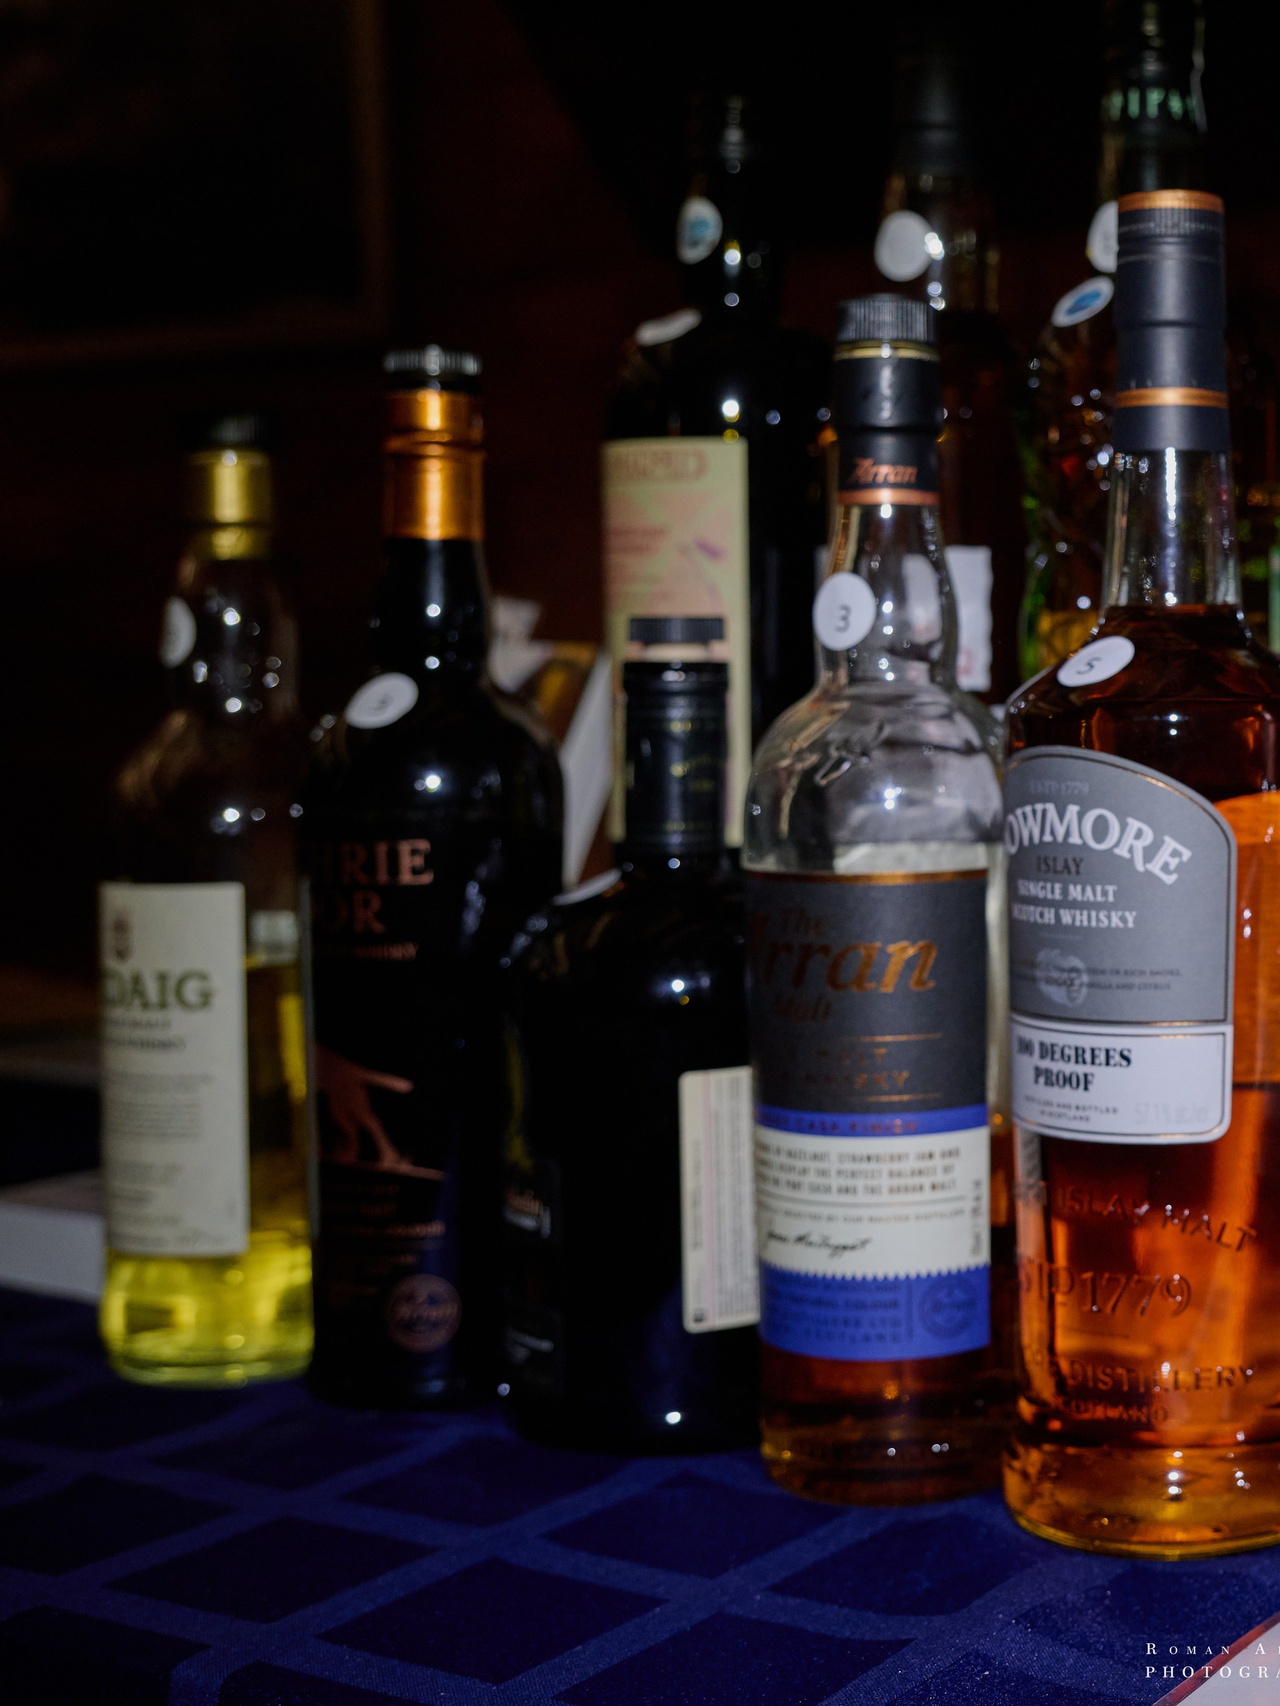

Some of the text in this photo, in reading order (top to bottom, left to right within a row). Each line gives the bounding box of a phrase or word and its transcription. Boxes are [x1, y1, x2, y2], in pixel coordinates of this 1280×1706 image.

[851, 457, 918, 485] Arran
[835, 603, 850, 633] 3
[1005, 802, 1193, 886] OWMORE
[1037, 855, 1083, 877] ISLAY
[1067, 883, 1118, 902] MALT
[1059, 907, 1137, 929] WHISKY
[1039, 1040, 1133, 1068] DEGREES
[1033, 1066, 1095, 1091] PROOF
